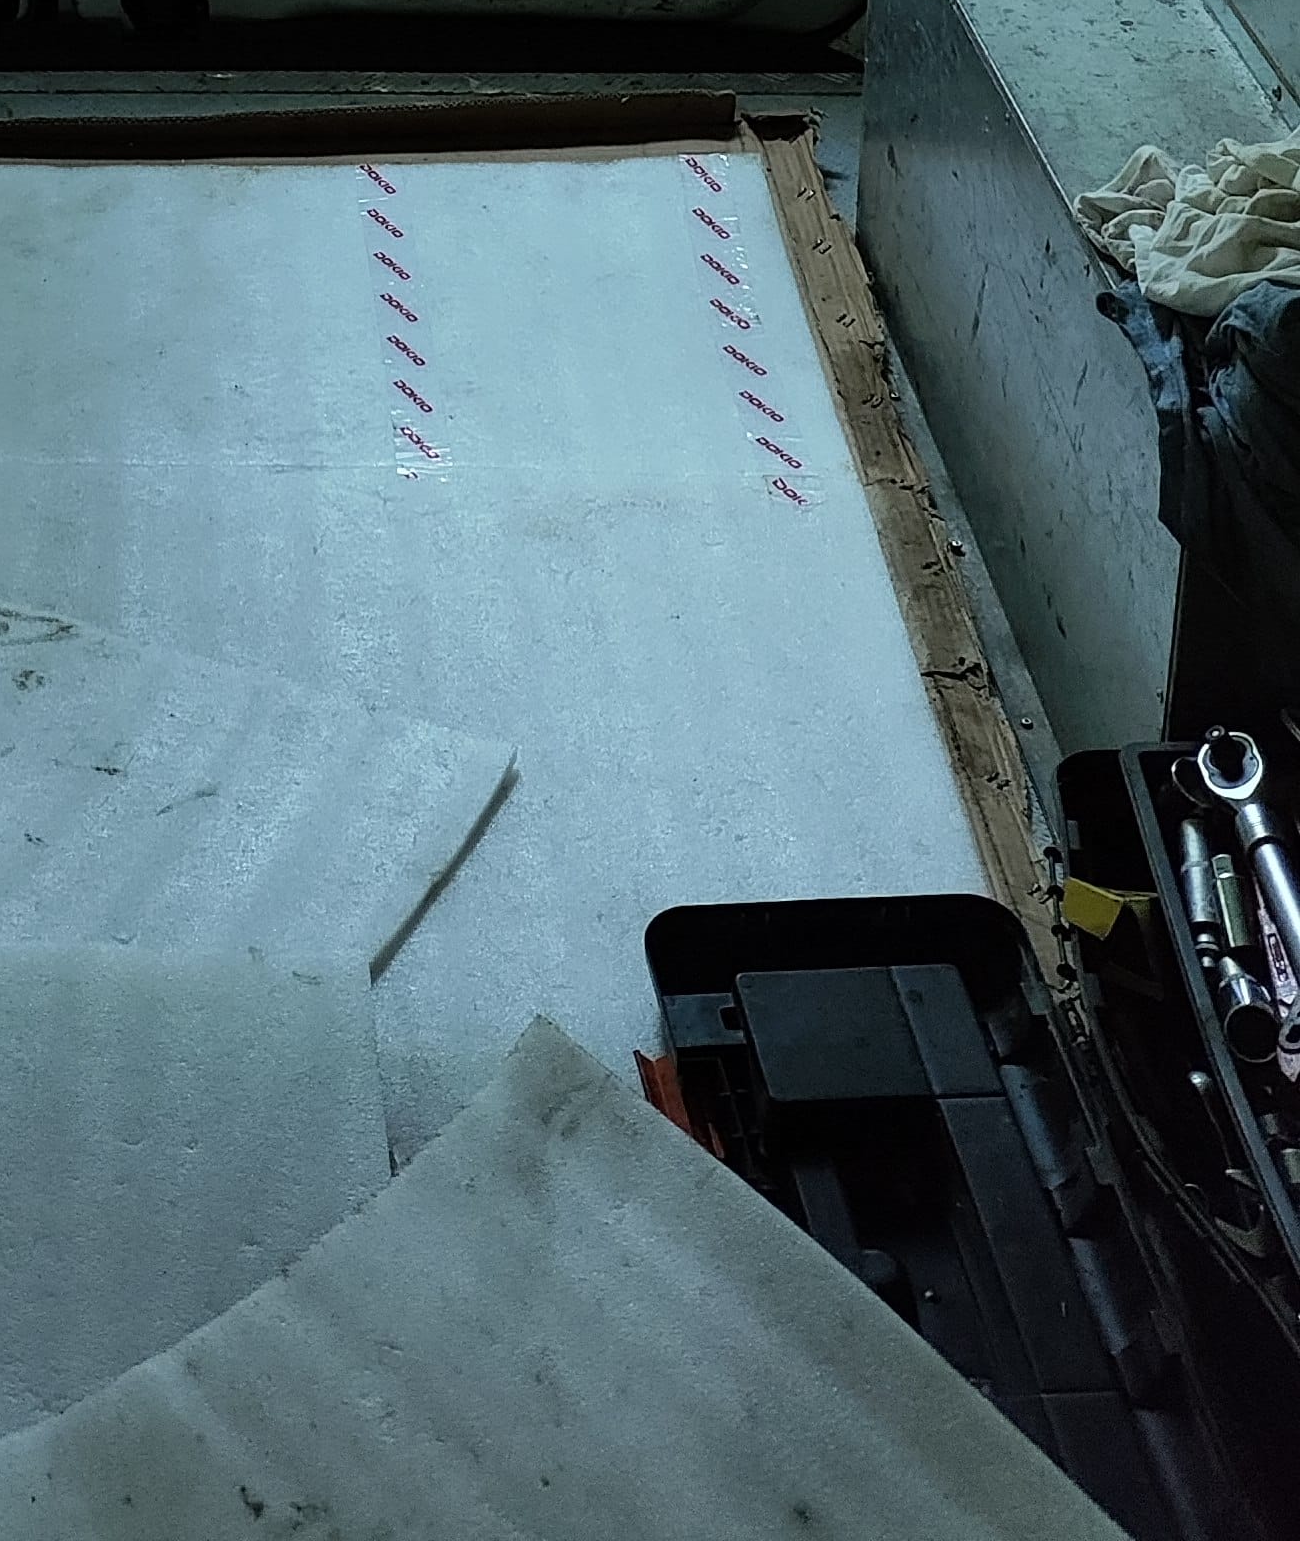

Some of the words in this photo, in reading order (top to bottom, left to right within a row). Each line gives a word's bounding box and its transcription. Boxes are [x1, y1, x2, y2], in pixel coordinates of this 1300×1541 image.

[358, 164, 397, 194] DOKIO
[685, 157, 722, 192] DOKIO
[367, 209, 403, 238] DOKIO
[692, 208, 730, 239] DOKIO
[373, 252, 411, 280] DOKIO
[700, 254, 740, 285] DOKIO
[380, 293, 418, 322] DOKIO
[386, 335, 425, 366] DOKIO
[723, 345, 767, 376] DOKIO
[393, 380, 433, 413] DOKIO
[739, 390, 784, 422] DOKIO
[755, 437, 802, 469] DOKIO
